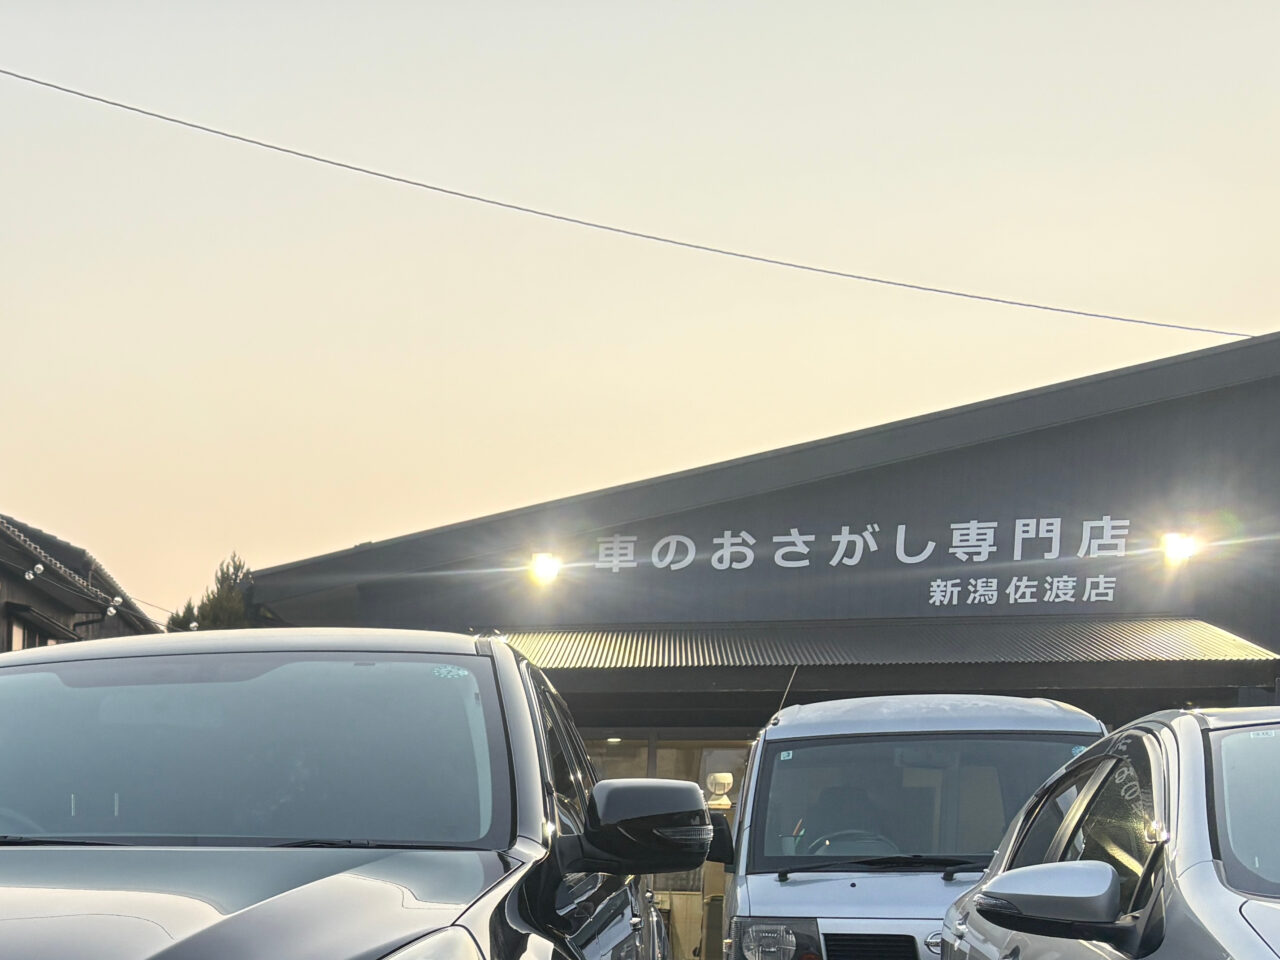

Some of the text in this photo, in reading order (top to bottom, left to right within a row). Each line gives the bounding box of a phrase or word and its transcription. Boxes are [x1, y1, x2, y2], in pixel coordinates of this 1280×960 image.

[593, 515, 1132, 574] 車のおさがし専門店
[928, 574, 1118, 607] 新潟佐渡店
